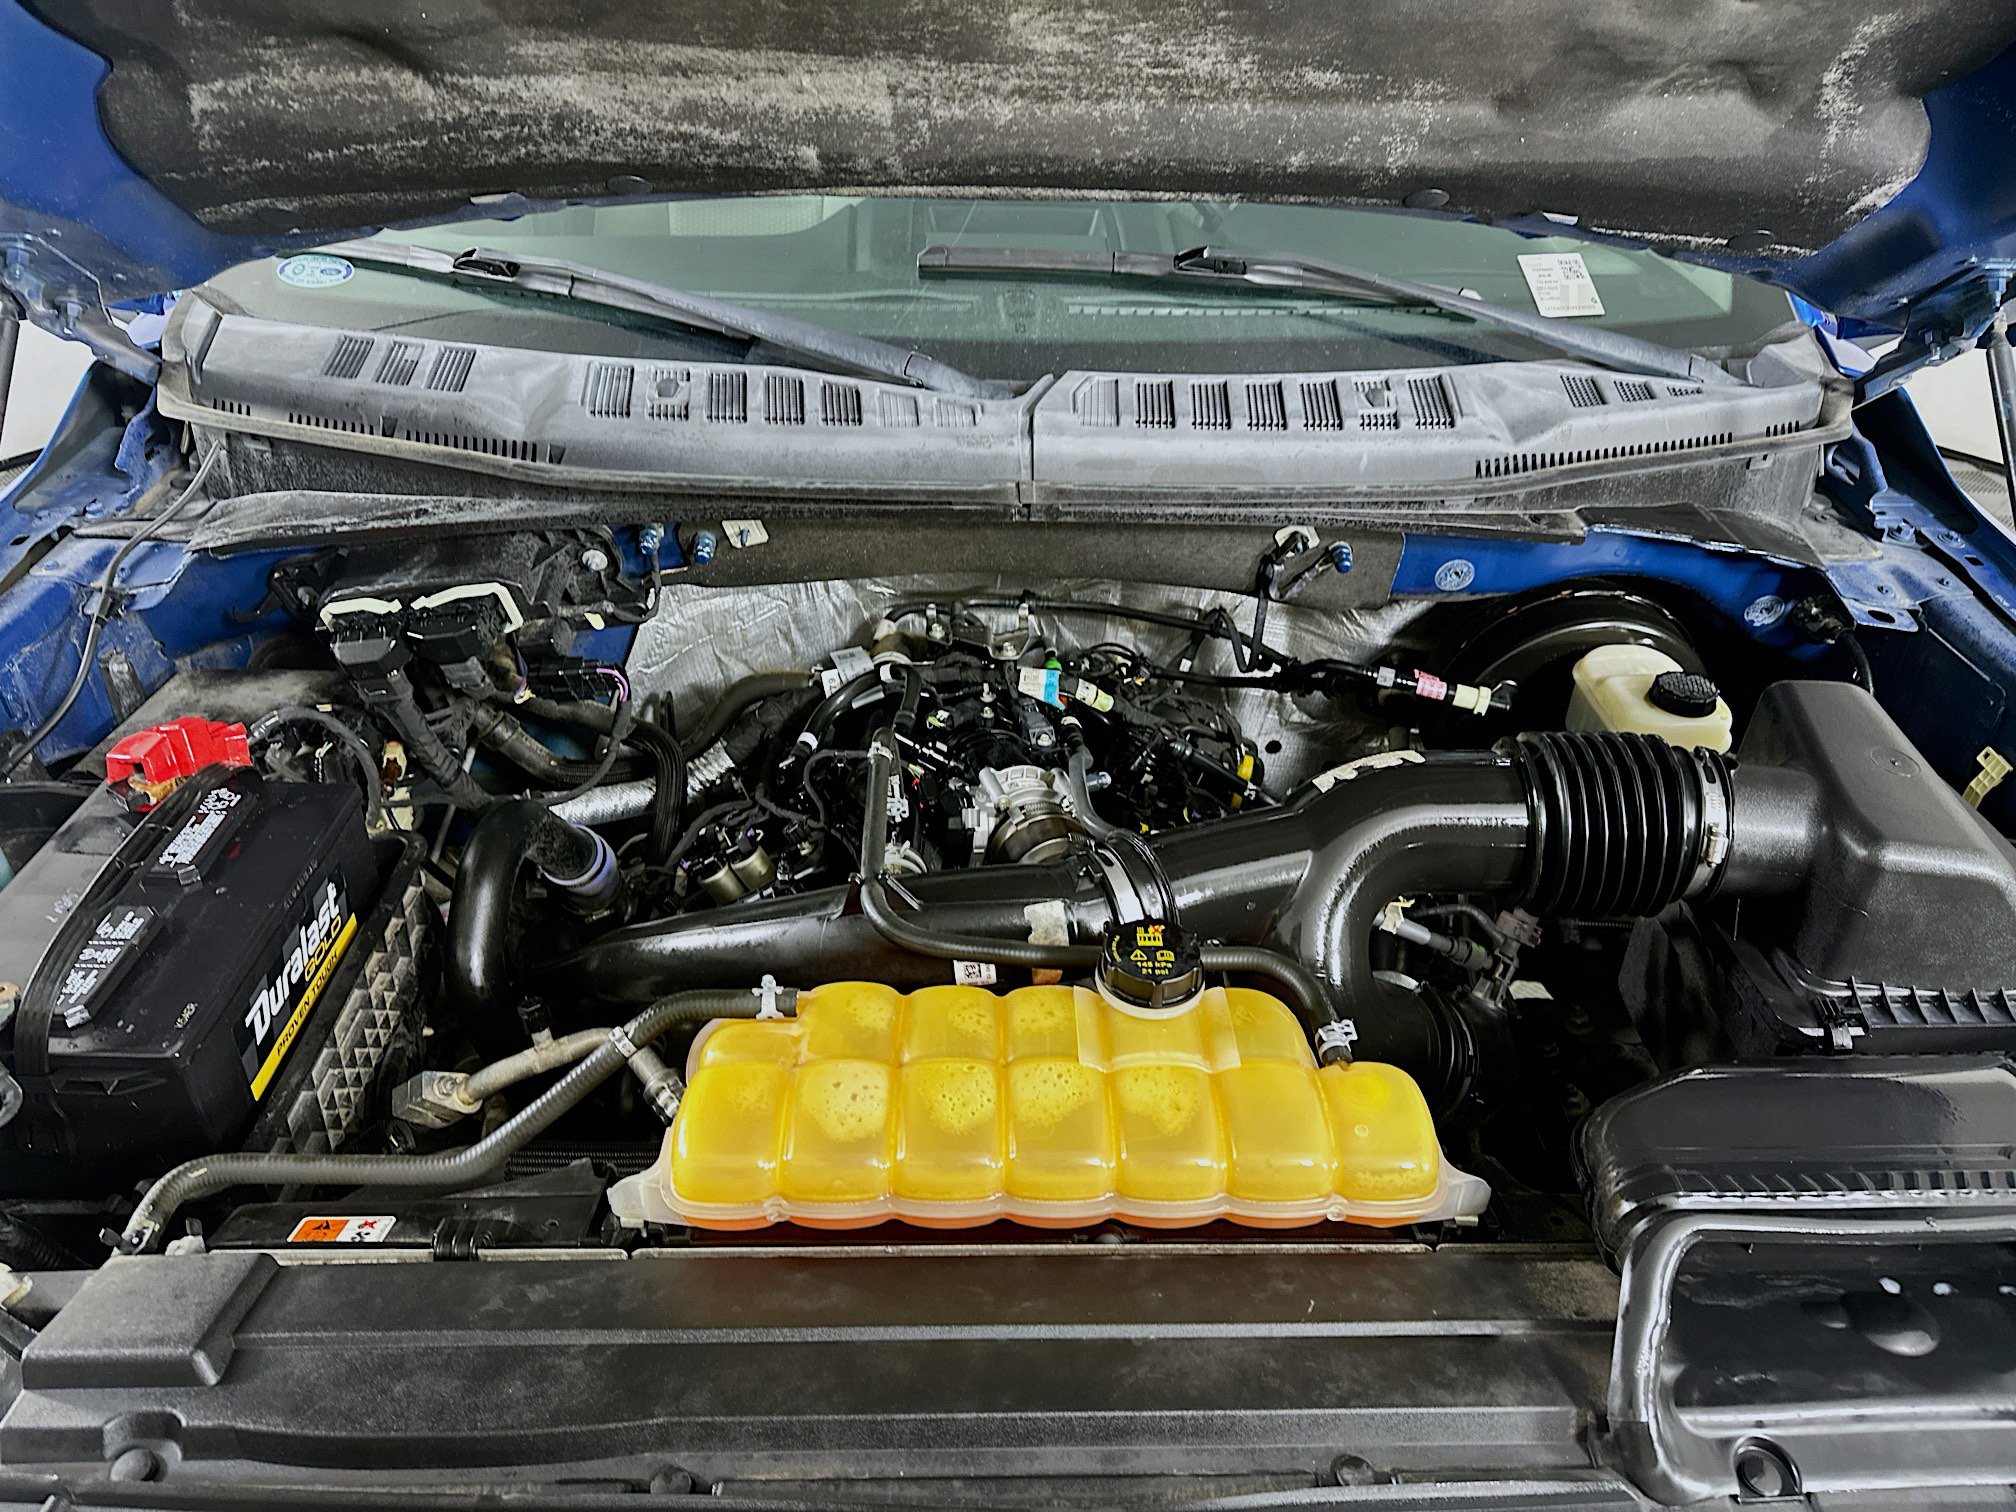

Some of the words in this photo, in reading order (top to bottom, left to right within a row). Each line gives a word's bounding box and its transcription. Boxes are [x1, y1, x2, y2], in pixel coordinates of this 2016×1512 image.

[245, 882, 339, 1046] Duralast
[304, 915, 341, 982] GOLD
[277, 996, 311, 1055] PROVEN
[312, 954, 338, 995] TOUGH
